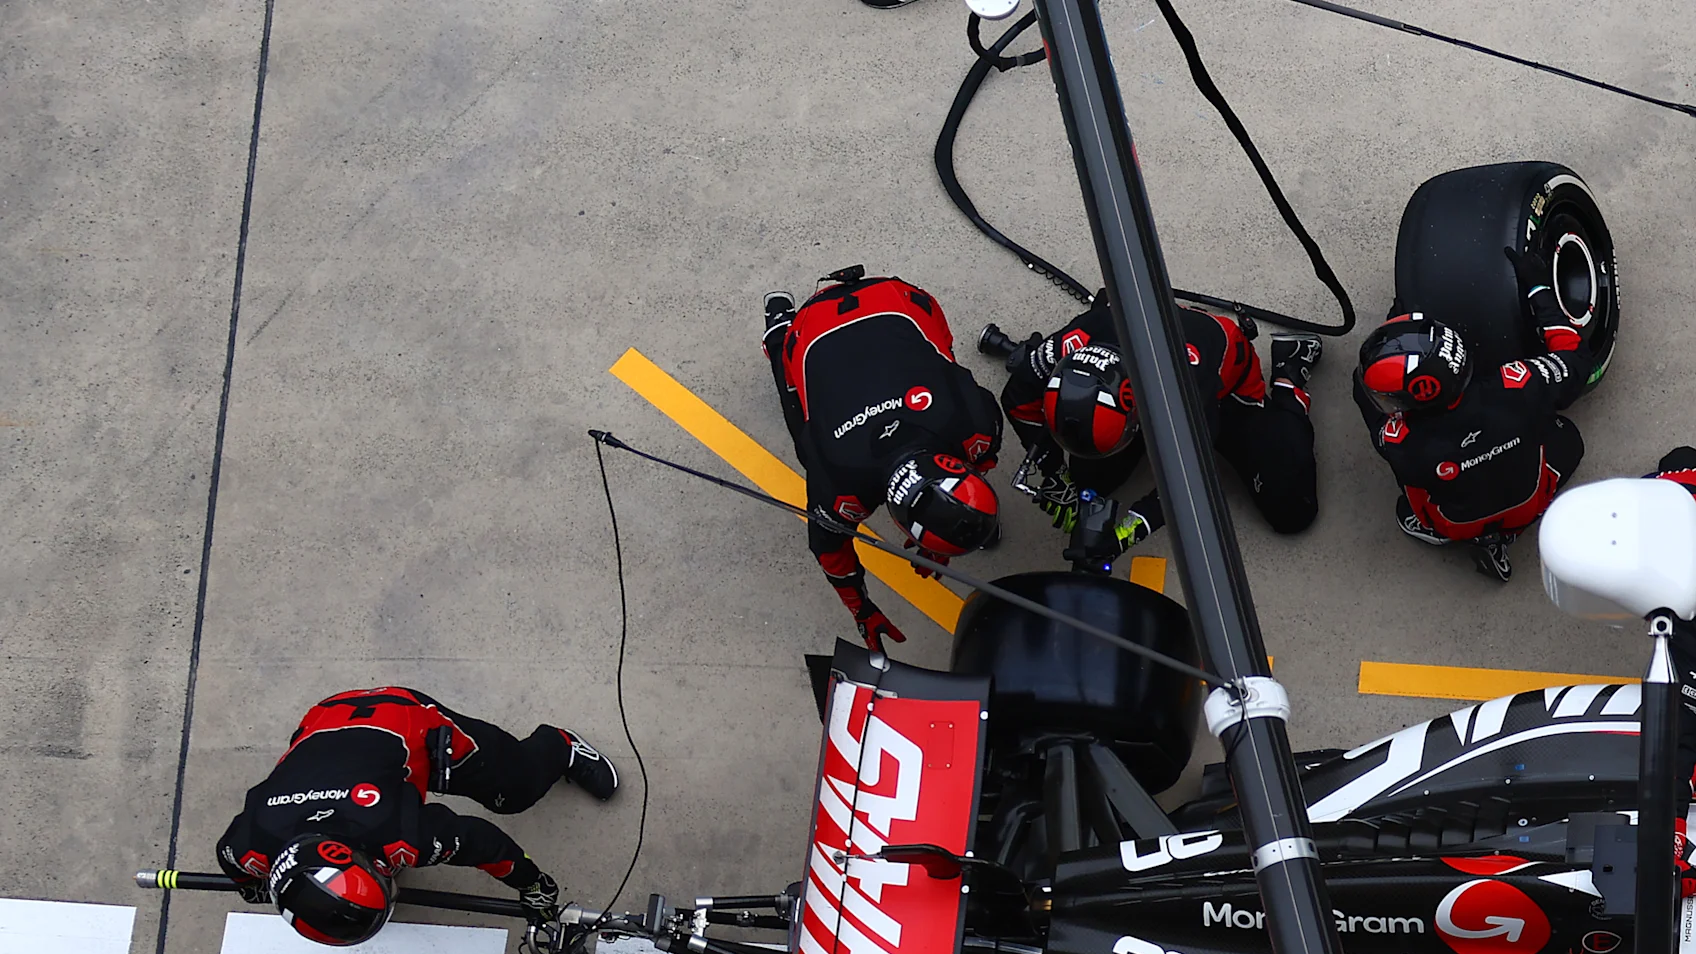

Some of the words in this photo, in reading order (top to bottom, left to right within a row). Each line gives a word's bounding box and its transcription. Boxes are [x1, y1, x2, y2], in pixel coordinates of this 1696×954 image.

[834, 397, 903, 439] MoneyGram
[1460, 436, 1521, 472] MoneyGram
[266, 788, 350, 807] MoneyGram
